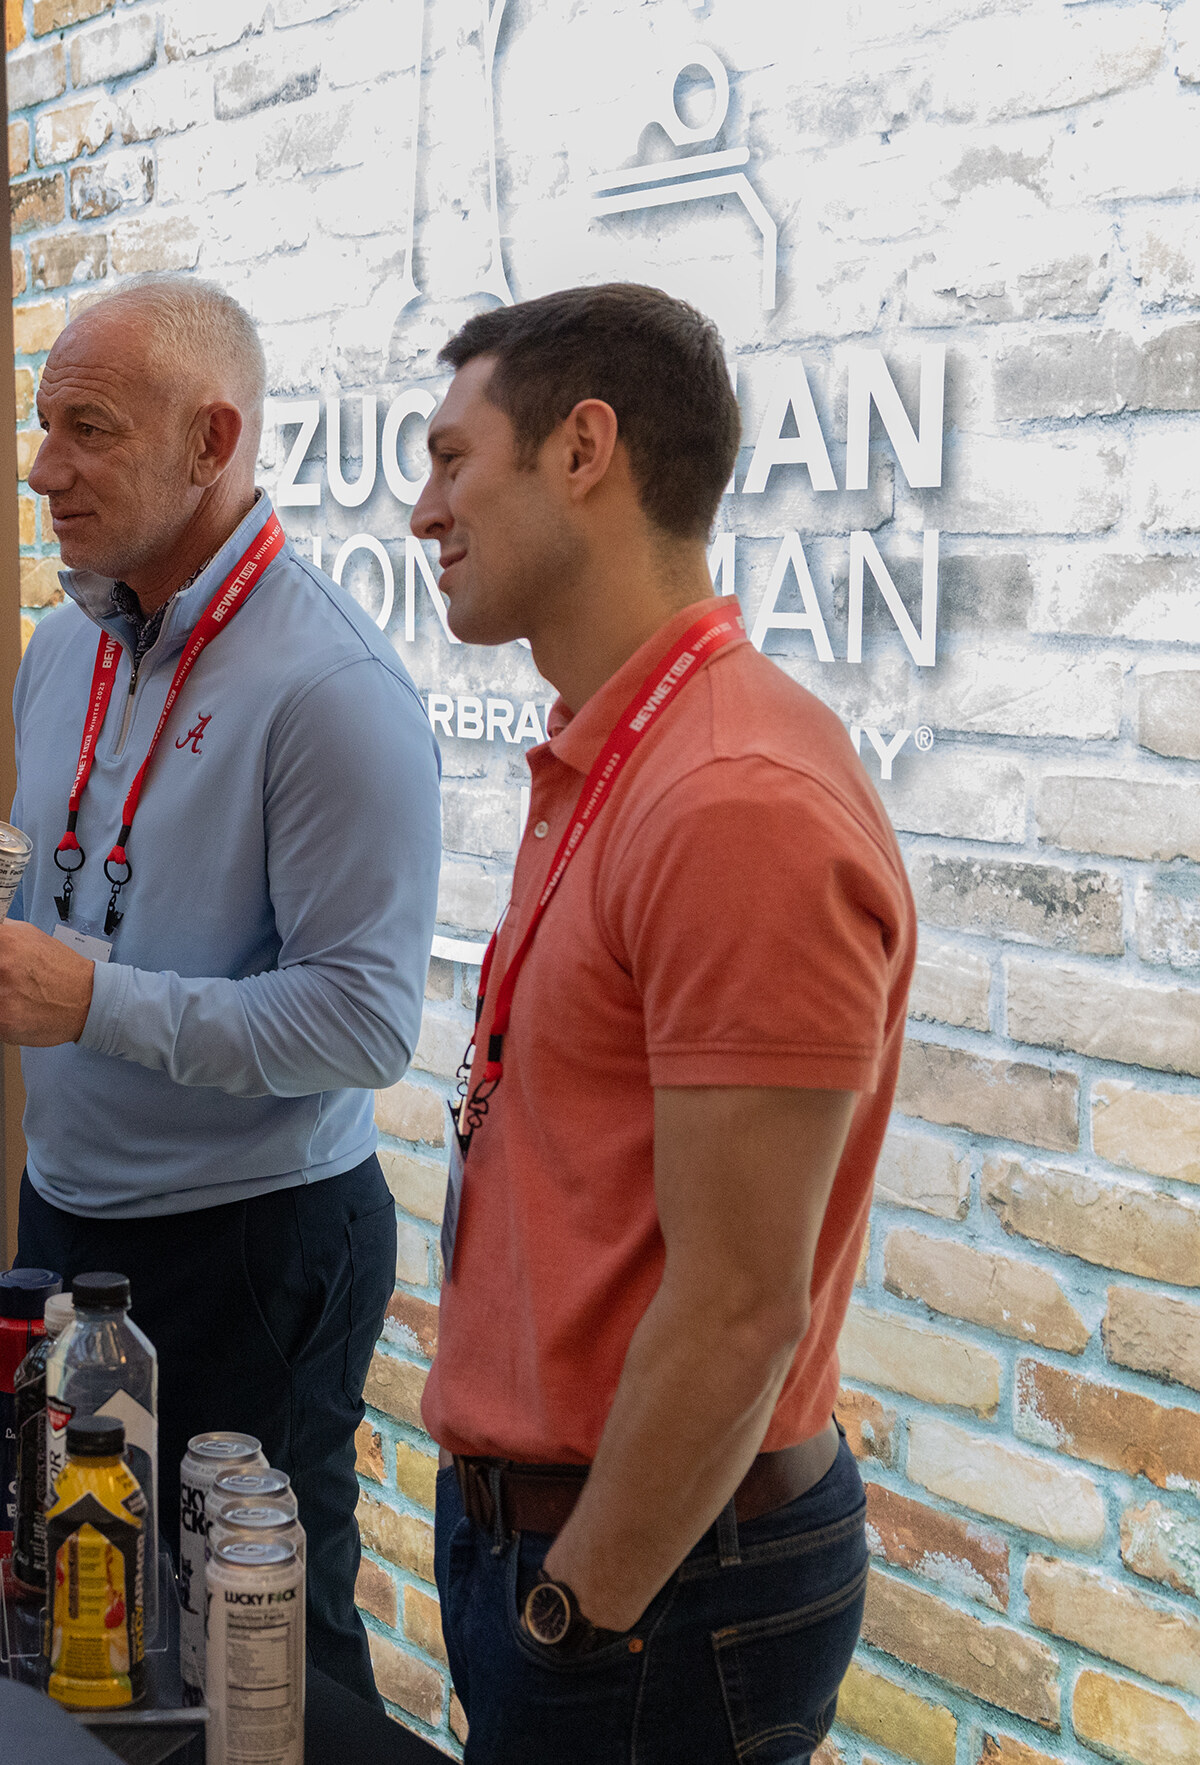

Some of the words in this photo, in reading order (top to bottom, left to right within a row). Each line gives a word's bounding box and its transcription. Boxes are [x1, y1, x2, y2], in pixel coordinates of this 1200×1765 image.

[211, 577, 243, 623] BEVNET
[253, 533, 275, 561] WINTER
[174, 655, 193, 687] WINTER
[190, 636, 205, 658] 2023
[88, 701, 101, 732] WINTER
[96, 681, 106, 701] 2023
[628, 671, 677, 732] BEVNET
[582, 779, 606, 820] WINTER
[602, 752, 621, 779] 2023
[224, 1590, 265, 1606] LUCKY
